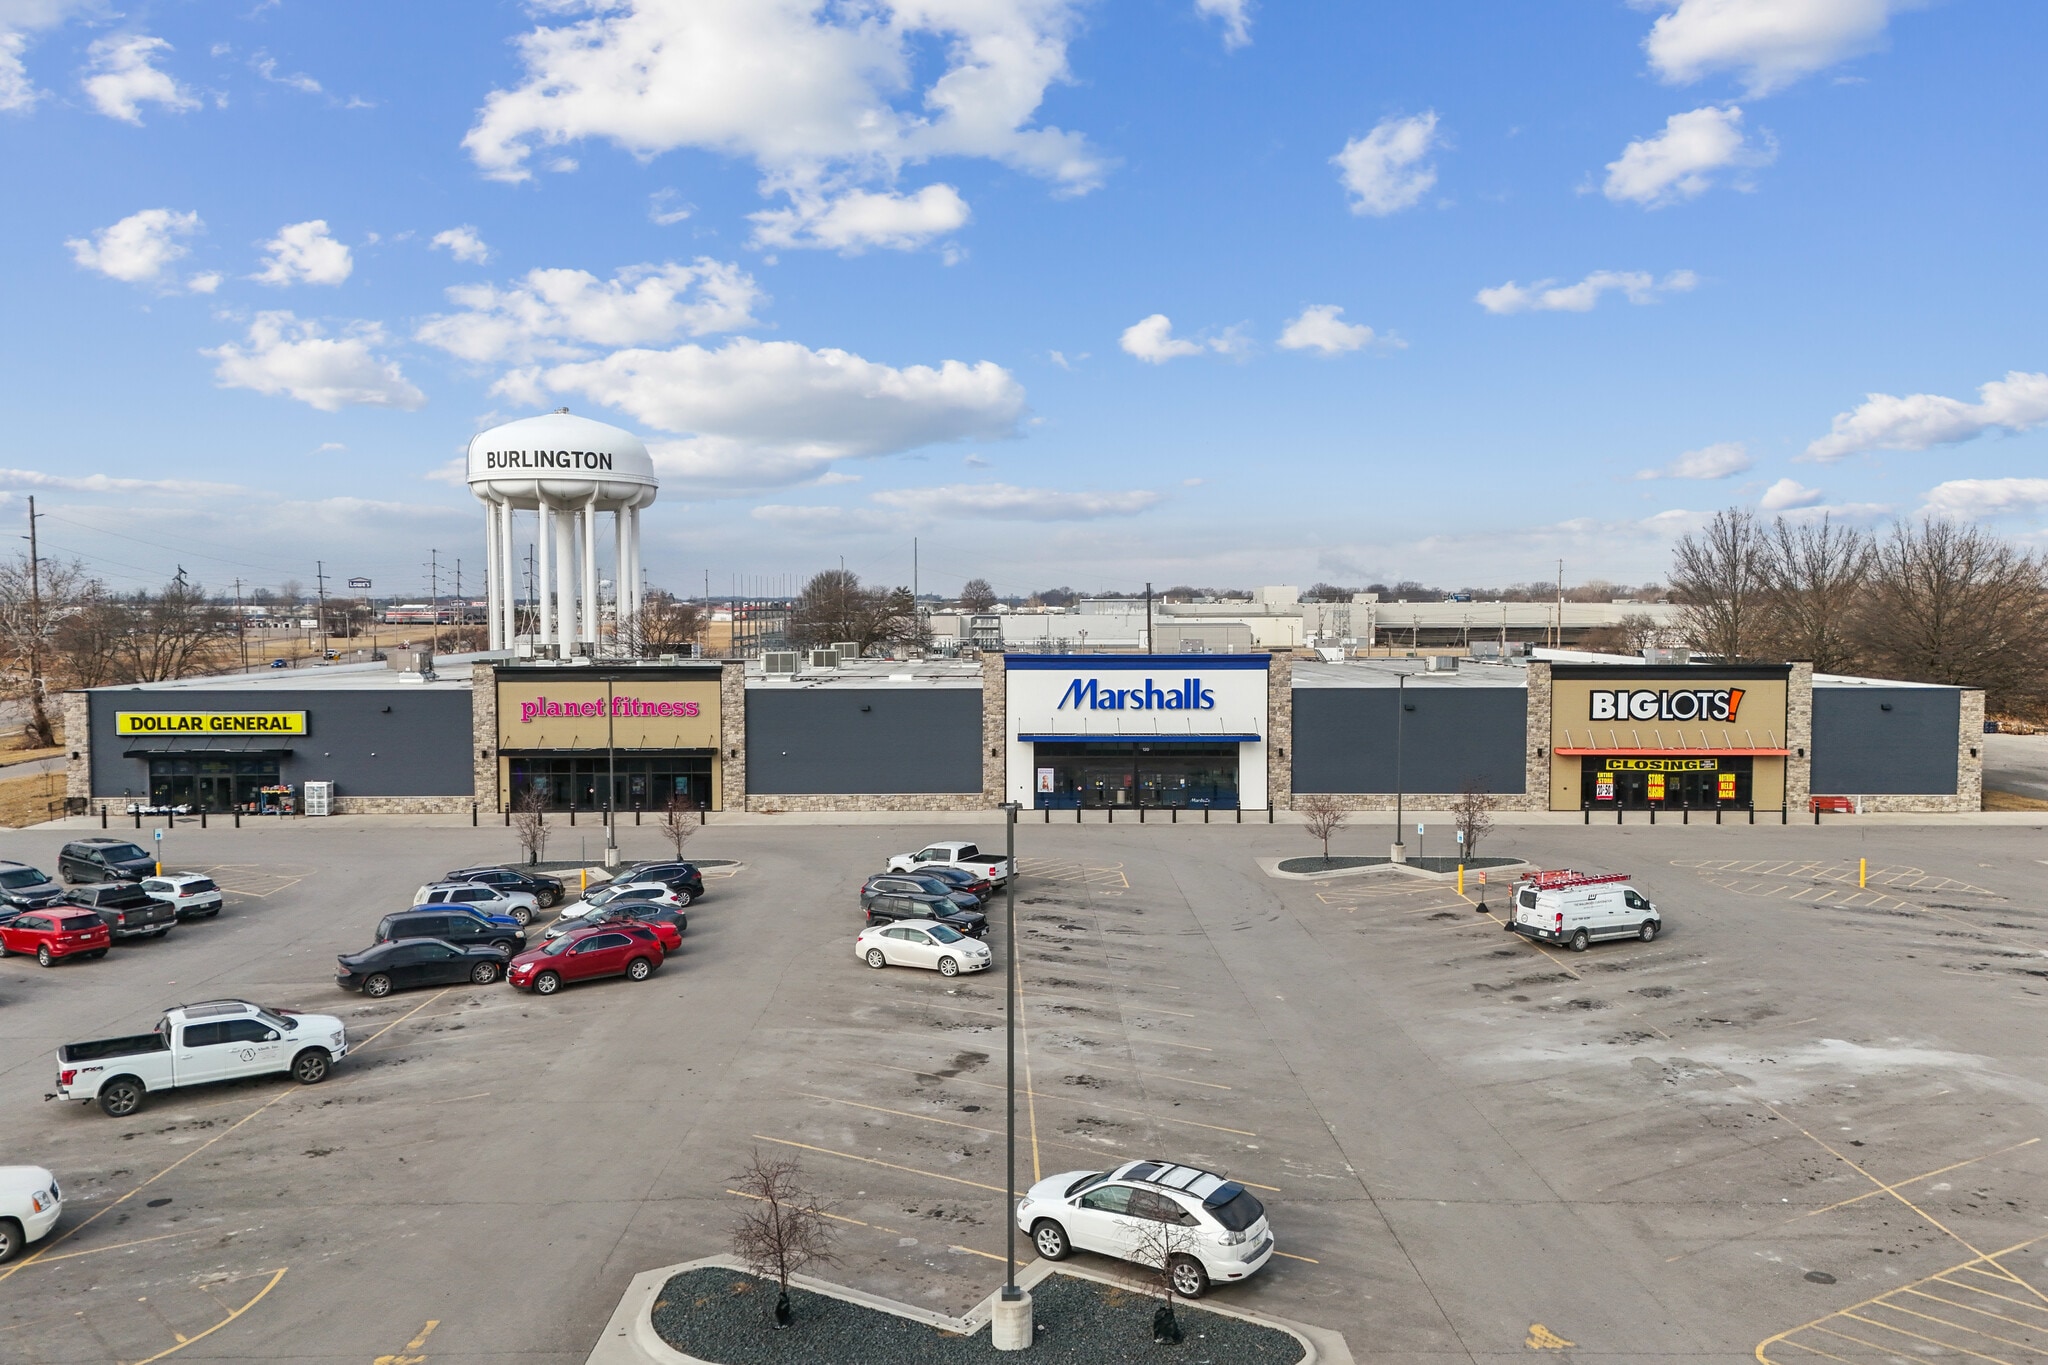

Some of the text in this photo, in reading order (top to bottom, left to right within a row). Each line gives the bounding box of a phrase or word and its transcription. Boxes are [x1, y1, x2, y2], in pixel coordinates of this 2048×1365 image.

[486, 450, 613, 470] BURLINGTON
[1056, 677, 1216, 711] Marshalls
[520, 696, 700, 723] planet fitness
[129, 716, 293, 731] DOLLAR GENERAL
[1608, 760, 1698, 769] CLOSING
[1648, 774, 1664, 785] STORE
[81, 1065, 104, 1073] FX4
